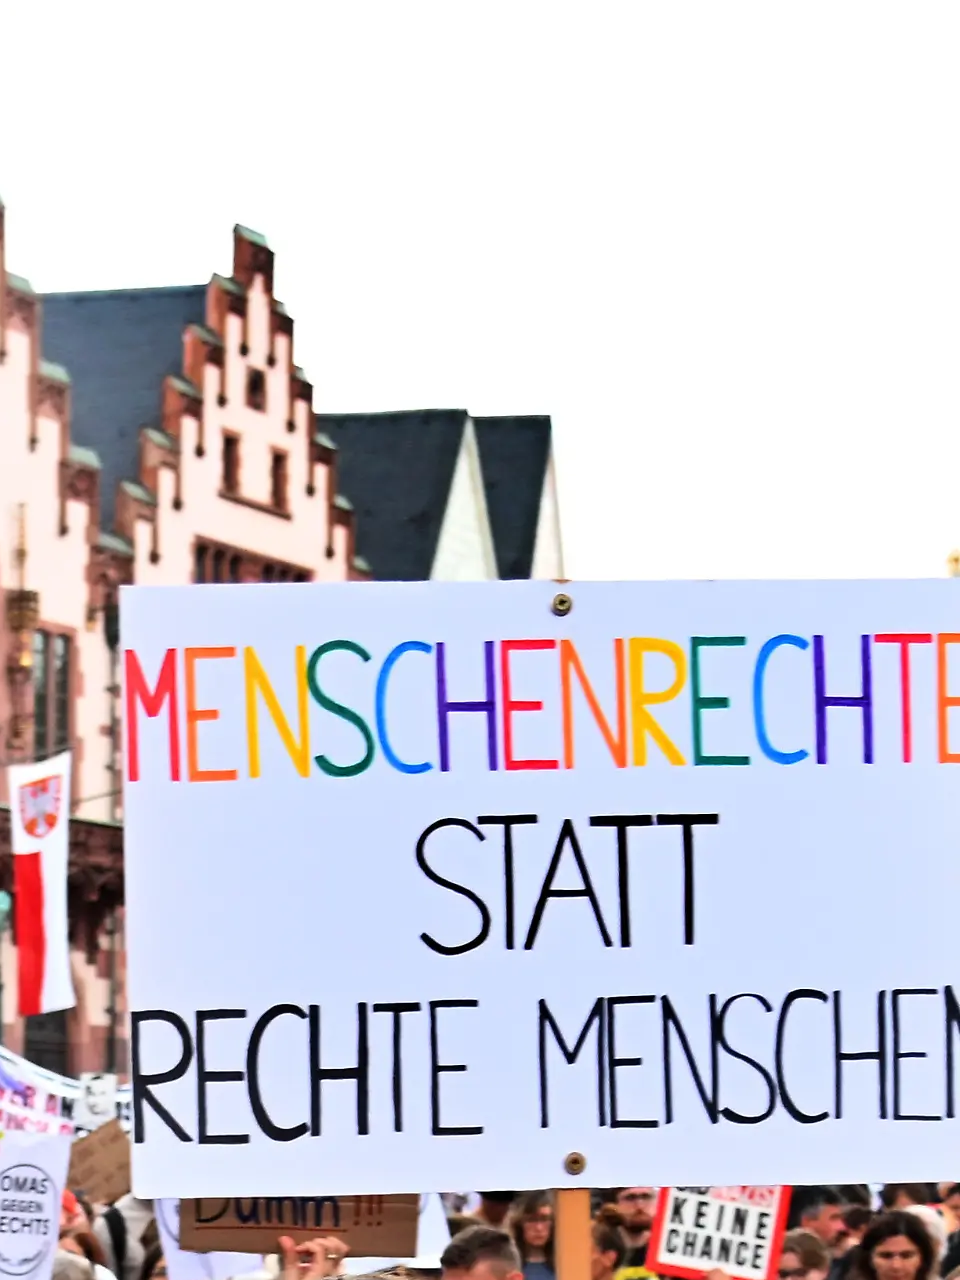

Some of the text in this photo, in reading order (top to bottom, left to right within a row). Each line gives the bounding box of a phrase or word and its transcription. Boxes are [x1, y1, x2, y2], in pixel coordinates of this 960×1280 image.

[416, 814, 719, 955] STATT
[131, 1000, 483, 1145] RECHTE
[0, 1175, 49, 1194] OMAS
[0, 1198, 44, 1213] GEGEN
[670, 1197, 771, 1239] KEINE
[665, 1228, 765, 1269] CHANCE
